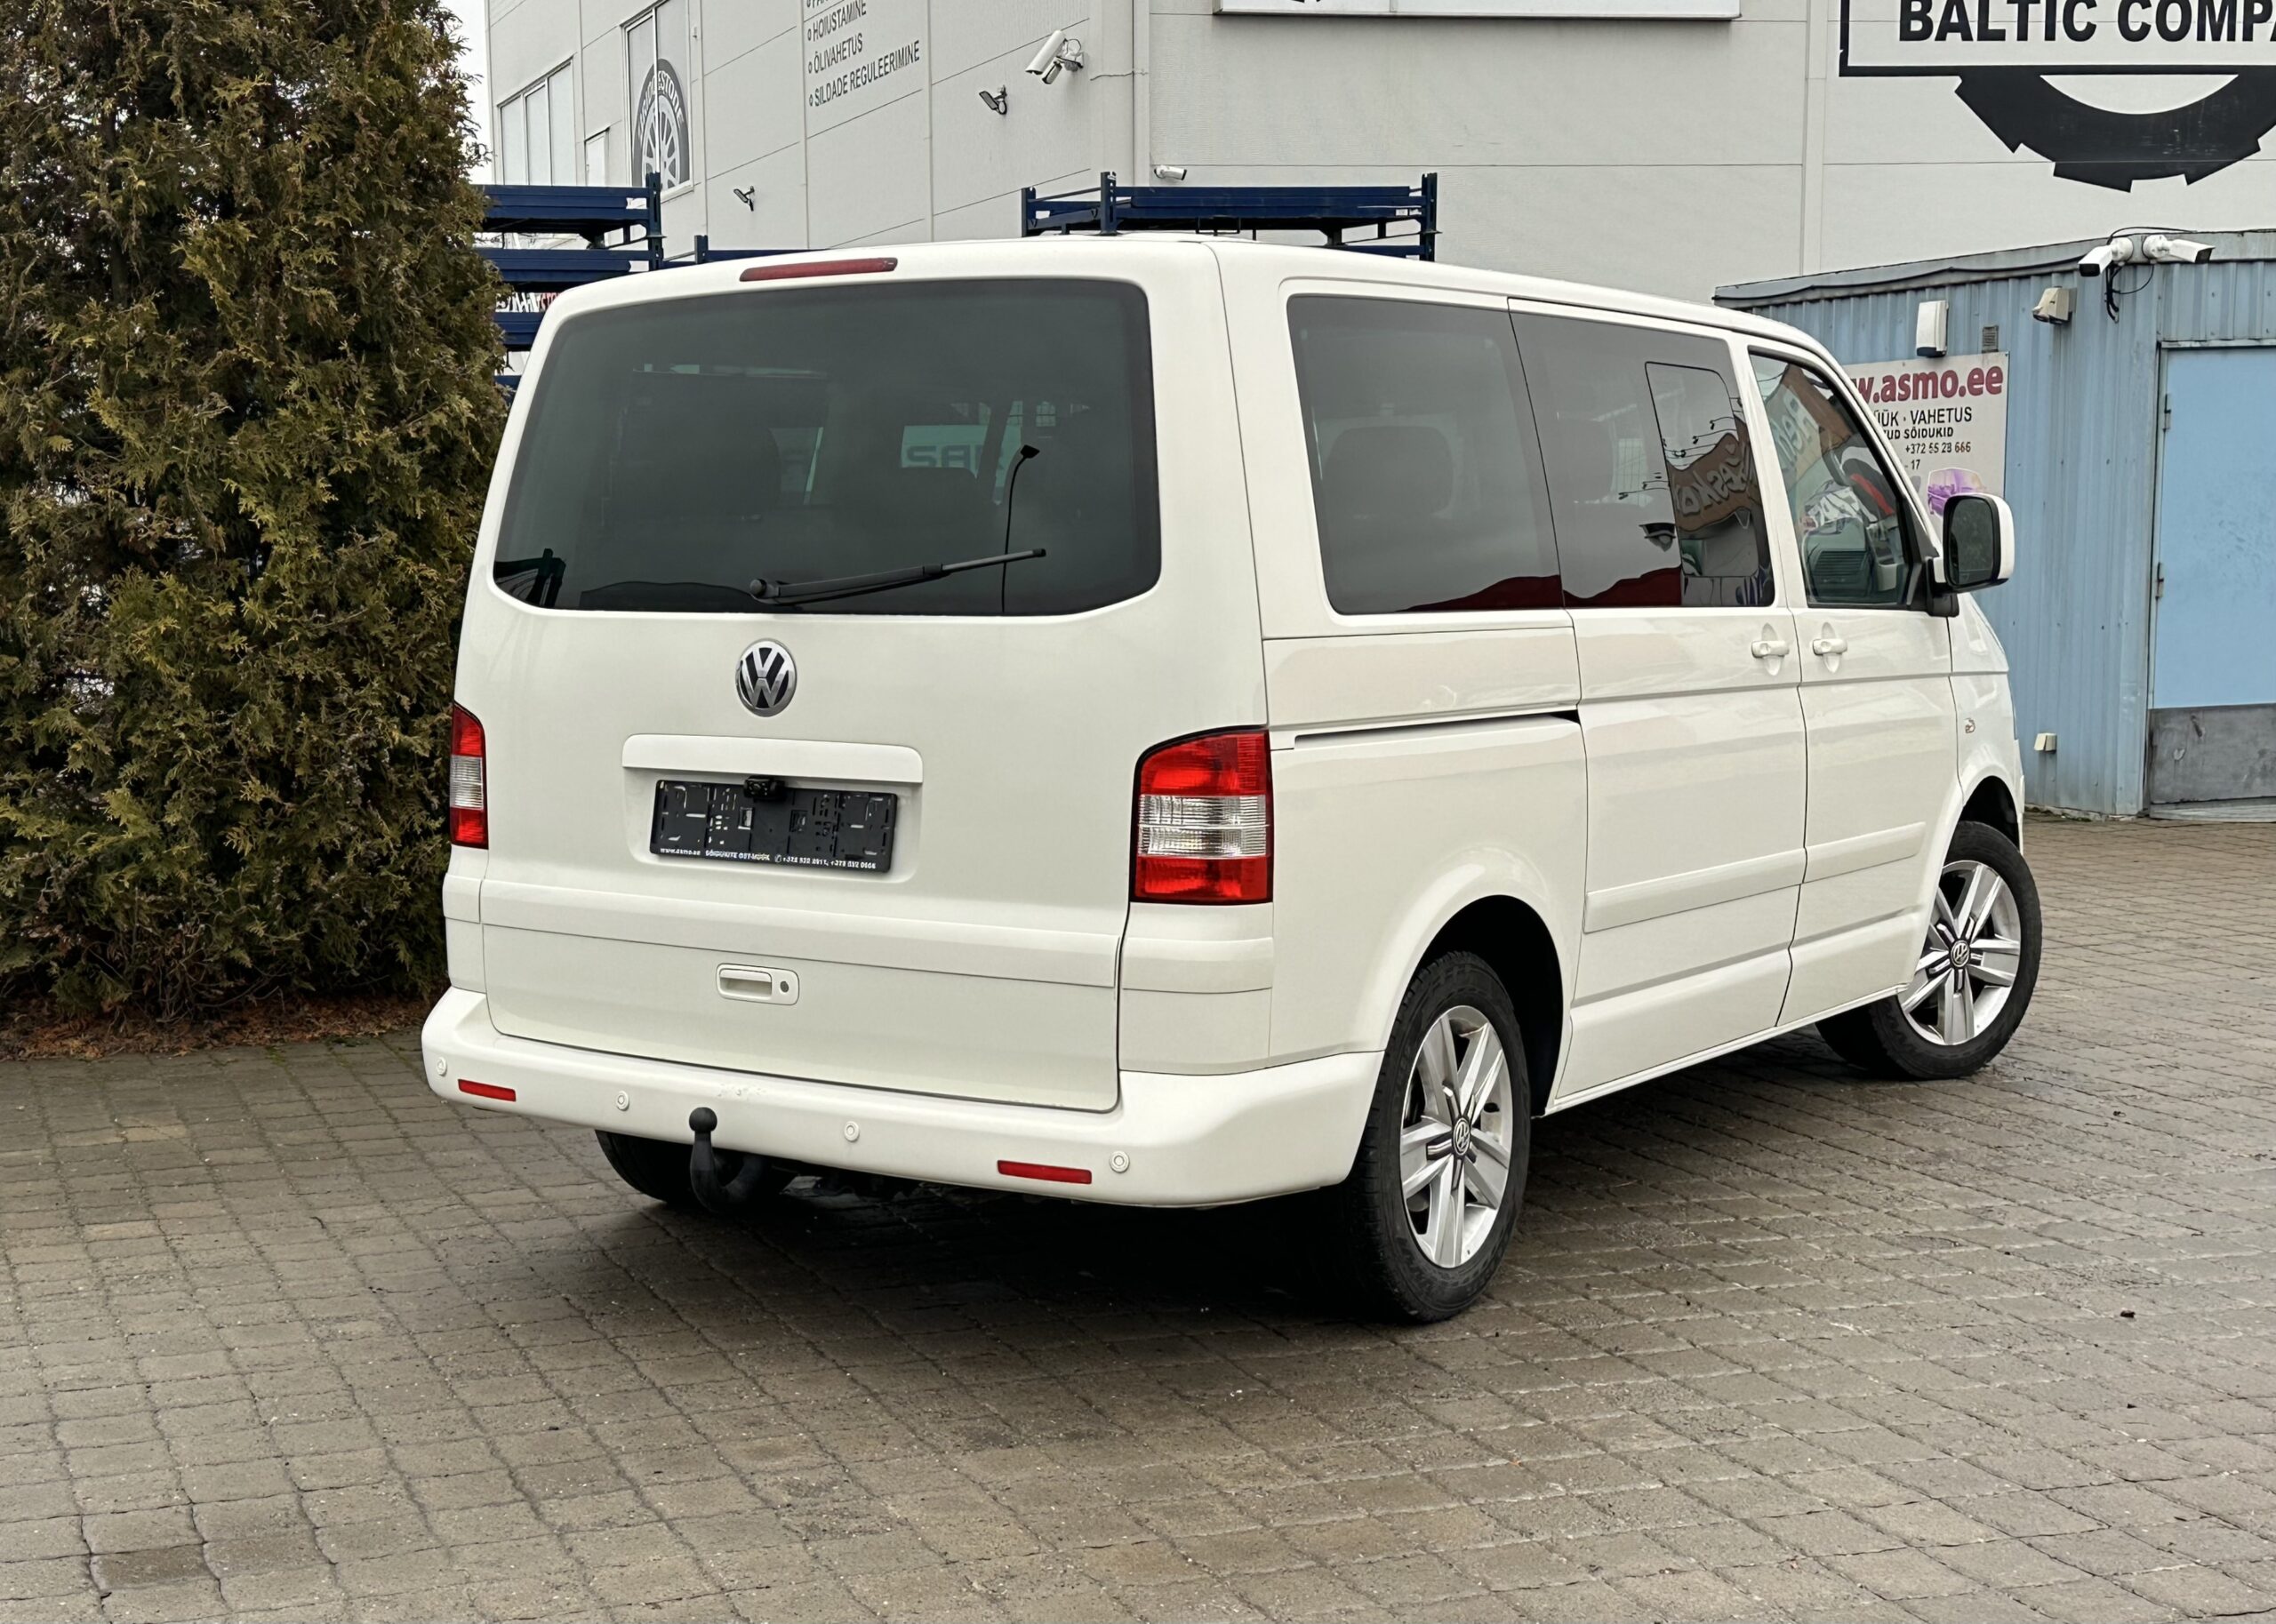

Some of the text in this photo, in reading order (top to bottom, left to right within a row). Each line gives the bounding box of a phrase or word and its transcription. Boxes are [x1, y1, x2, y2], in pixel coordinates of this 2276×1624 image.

[813, 0, 867, 42] HOIUSTAMINE
[1899, 0, 2276, 42] BALTIC COMP
[813, 33, 863, 74] ÕLIVAHETUS
[814, 39, 920, 107] SILDADE REGULEERIMINE
[1852, 365, 2004, 404] w.asmo.ee
[1884, 426, 1954, 440] UD SÕIDUKID
[1910, 406, 1973, 425] VAHETUS
[1905, 443, 1926, 454] +372
[1928, 443, 1940, 454] 55
[1911, 460, 1921, 470] 17
[737, 640, 796, 715] VW
